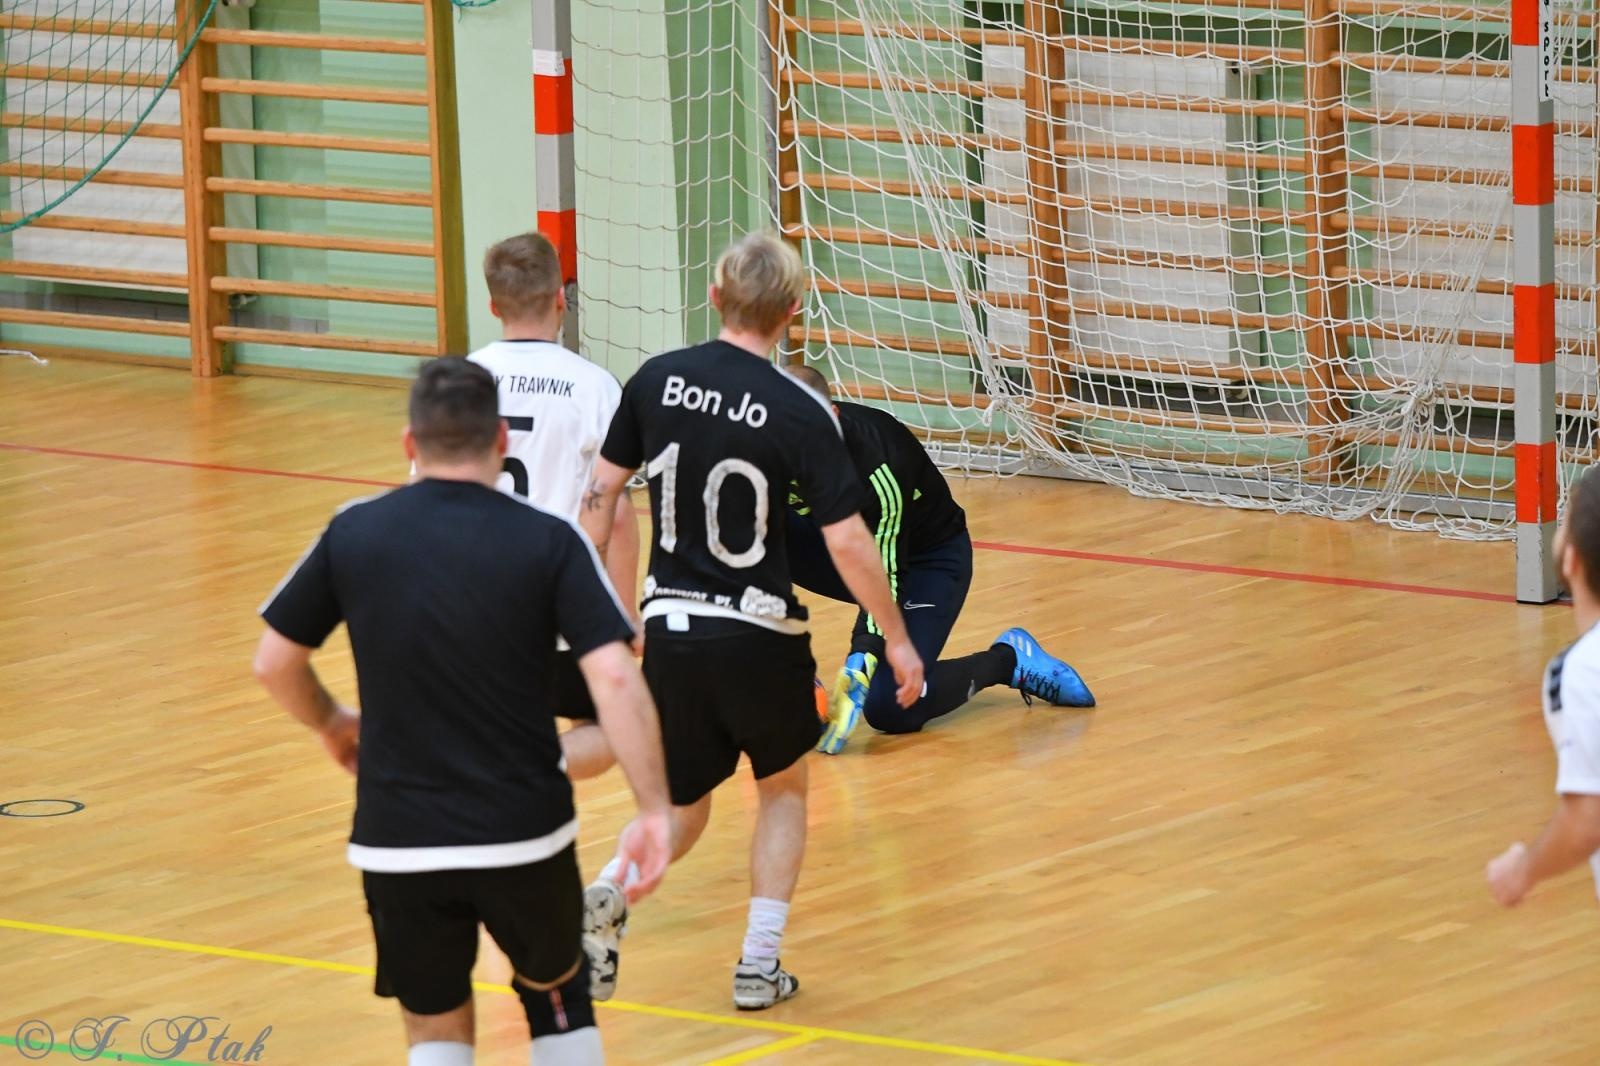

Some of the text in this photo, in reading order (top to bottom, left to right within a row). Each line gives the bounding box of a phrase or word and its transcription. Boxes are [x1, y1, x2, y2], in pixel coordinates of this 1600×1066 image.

[510, 375, 575, 398] TRAWNIK
[662, 376, 768, 428] Bon Jo
[646, 442, 769, 568] 10
